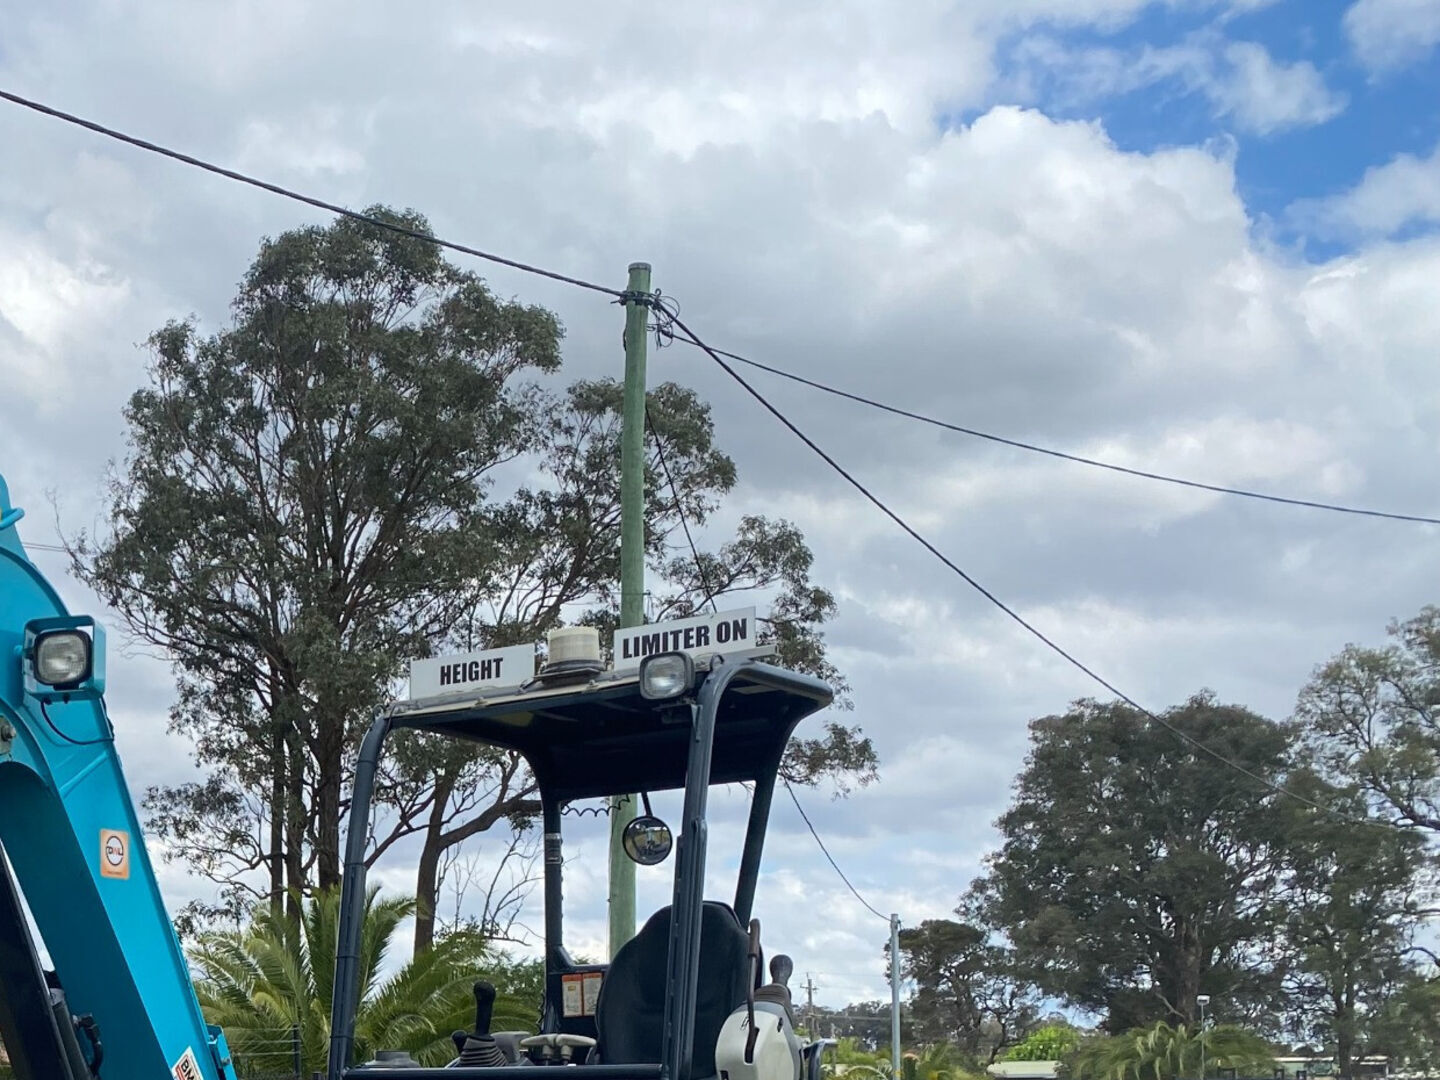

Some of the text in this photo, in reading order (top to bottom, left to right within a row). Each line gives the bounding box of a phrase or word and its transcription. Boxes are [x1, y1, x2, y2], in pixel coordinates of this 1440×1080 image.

[622, 618, 747, 659] LIMITER ON
[440, 657, 503, 686] HEIGHT
